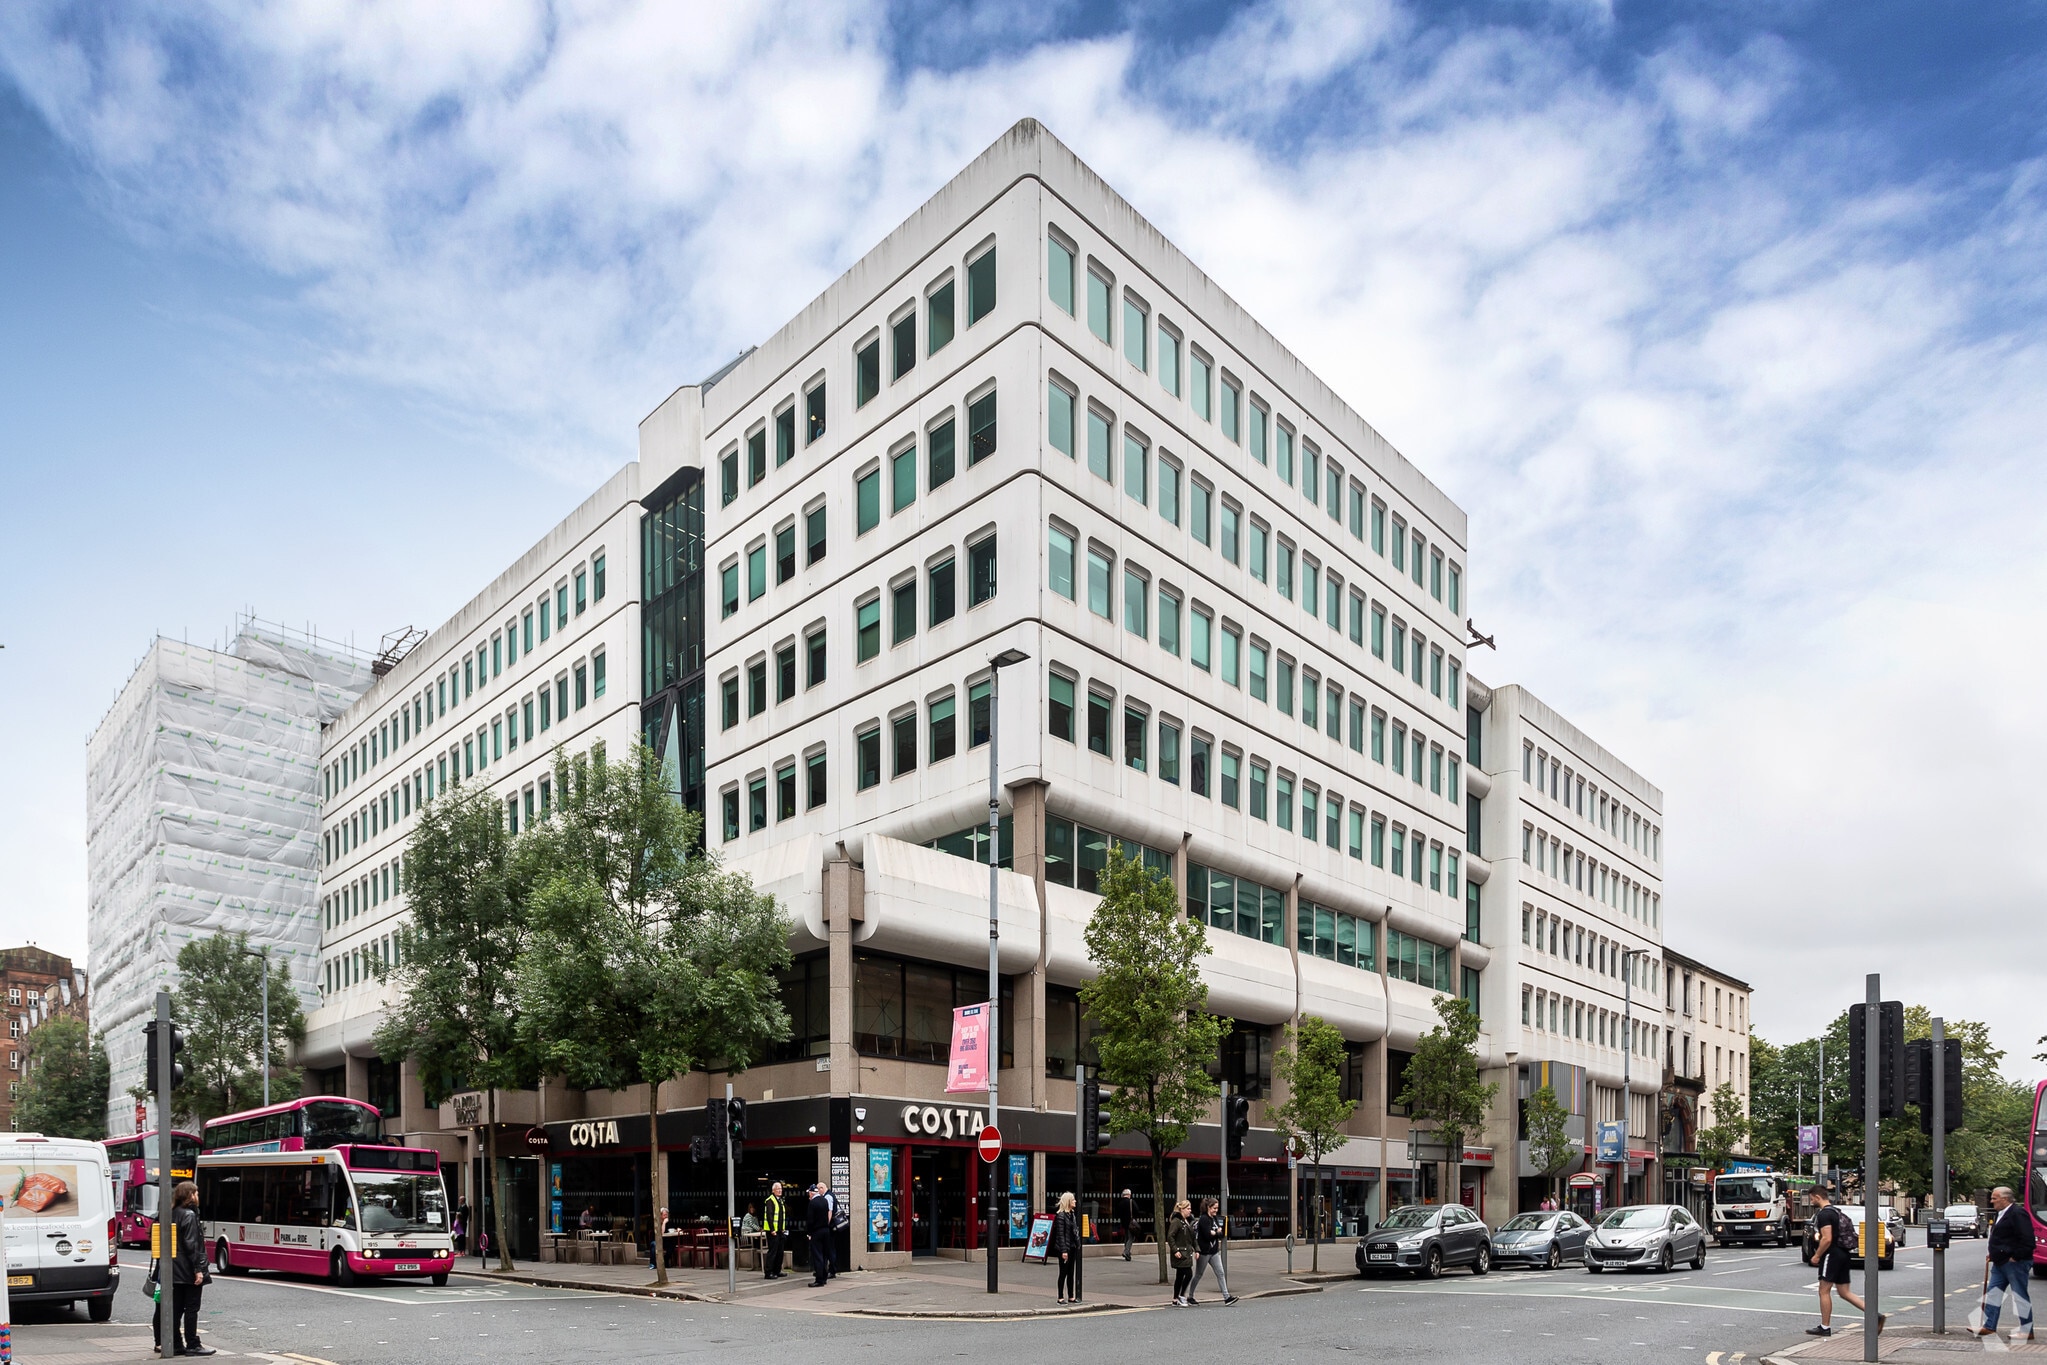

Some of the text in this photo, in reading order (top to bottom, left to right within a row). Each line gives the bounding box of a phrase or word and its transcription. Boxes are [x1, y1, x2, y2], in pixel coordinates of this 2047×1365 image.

[570, 1121, 619, 1148] COSTA
[901, 1105, 985, 1139] COSTA
[280, 1233, 291, 1242] PARK
[297, 1234, 308, 1243] RIDE
